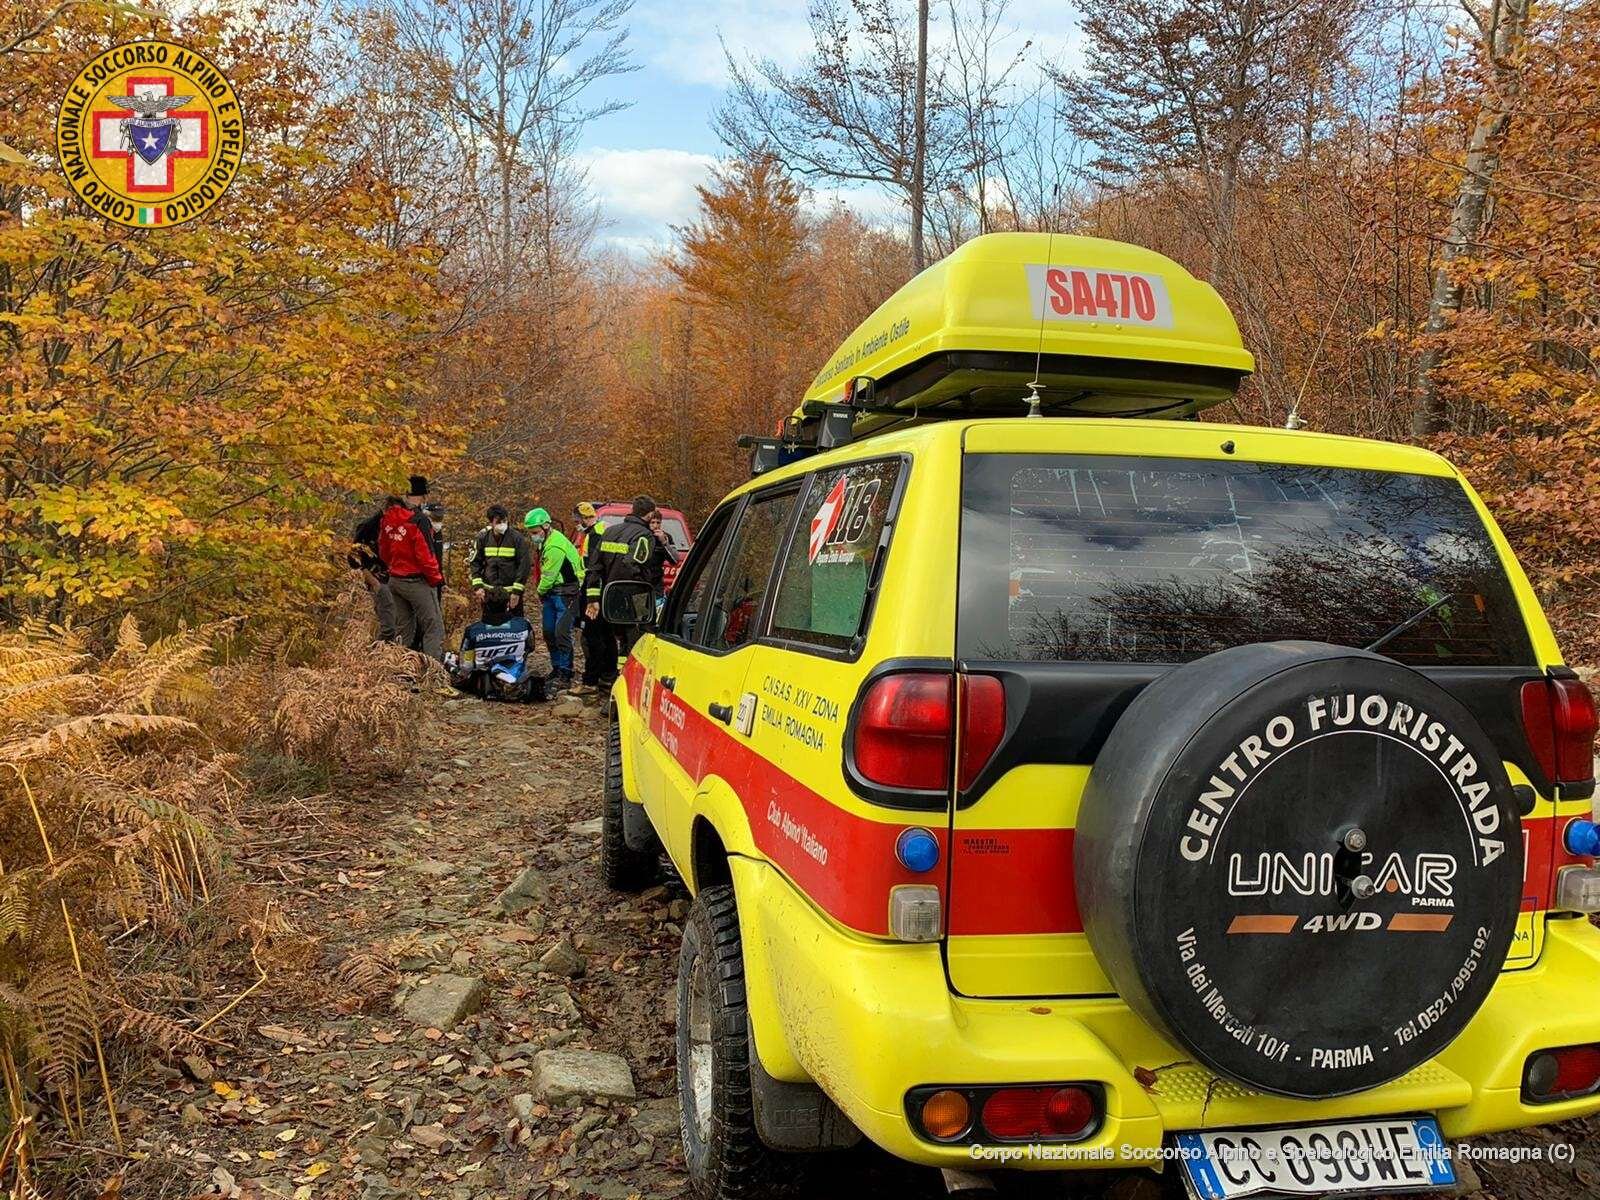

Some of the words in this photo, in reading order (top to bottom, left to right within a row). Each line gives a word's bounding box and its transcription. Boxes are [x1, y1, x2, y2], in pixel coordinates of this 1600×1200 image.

[1046, 268, 1156, 322] SA470
[794, 687, 813, 711] XXV
[812, 695, 839, 723] ZONA
[761, 704, 783, 730] EMILIA
[784, 716, 824, 752] ROMAGNA
[1180, 715, 1295, 862] CENTRO
[1308, 694, 1505, 867] FUORISTRADA
[1228, 852, 1458, 896] UNIAR
[1303, 911, 1383, 934] 4WD
[1412, 897, 1455, 907] PARMA
[1176, 927, 1197, 963] Via
[1186, 962, 1213, 994] dei
[1393, 926, 1492, 1047] Tel.0521/995192
[1202, 987, 1257, 1046] Mercati
[1311, 1045, 1375, 1069] PARMA
